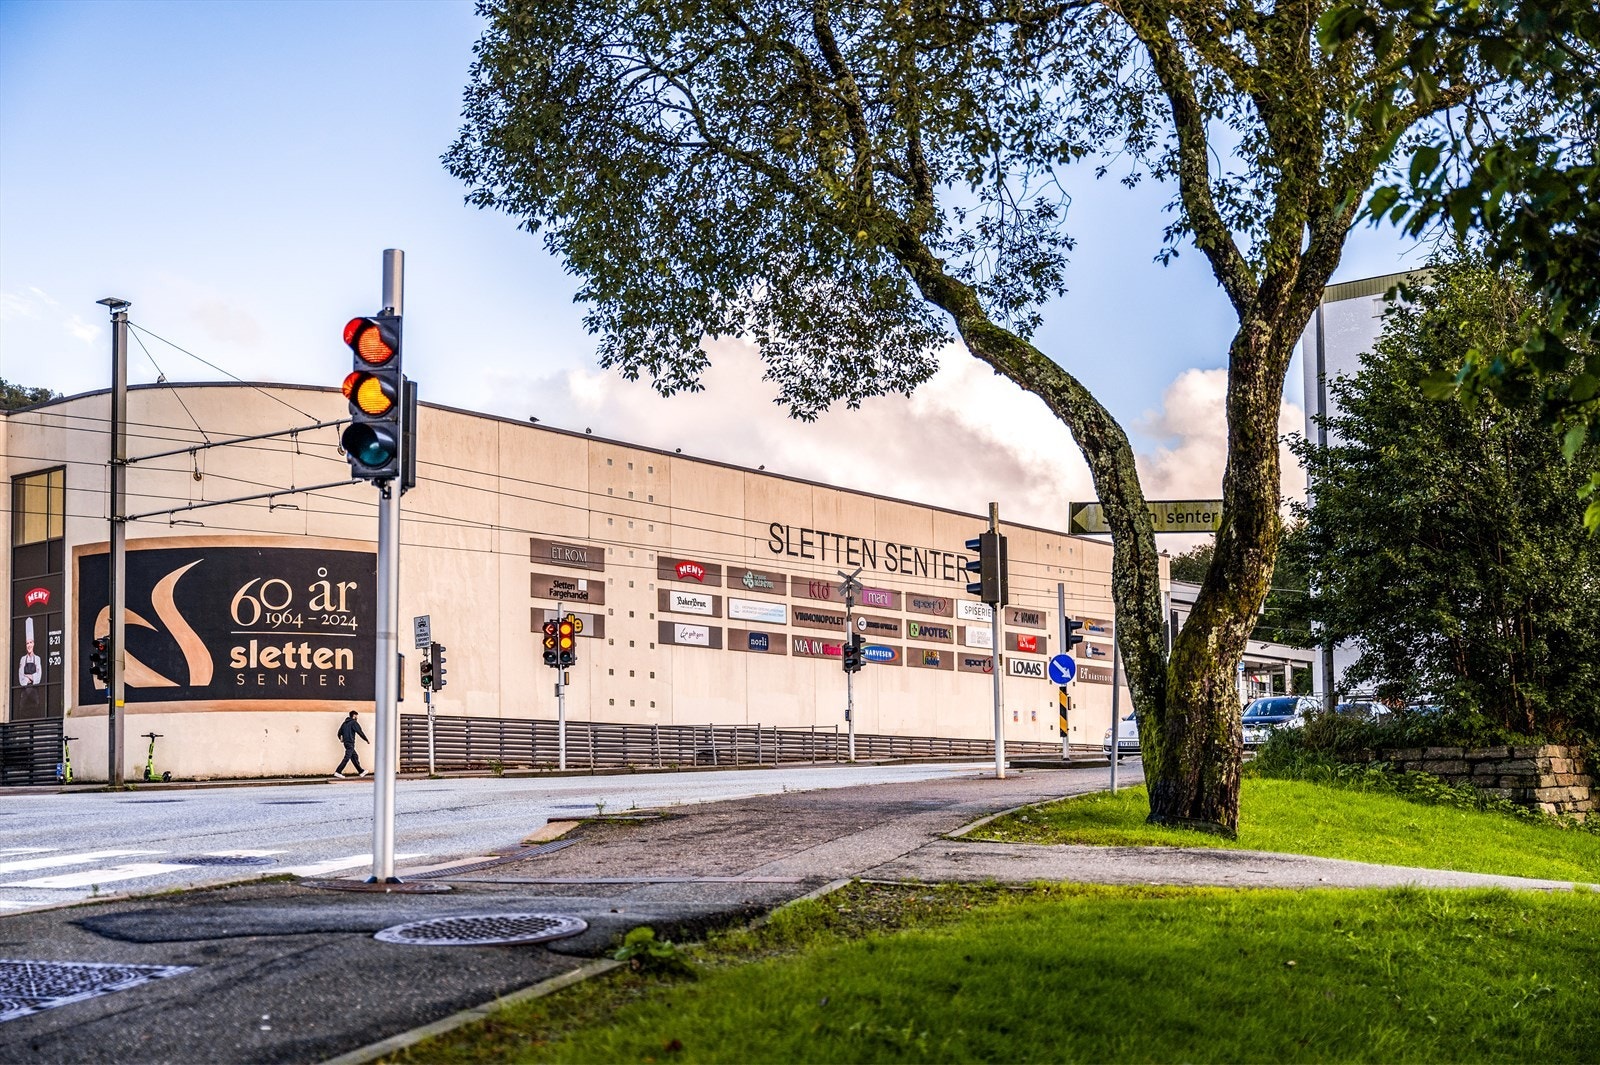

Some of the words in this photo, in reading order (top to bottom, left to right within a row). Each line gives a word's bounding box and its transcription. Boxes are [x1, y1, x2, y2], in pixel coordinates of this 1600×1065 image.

[1166, 511, 1218, 524] senter
[551, 546, 562, 559] ET
[565, 548, 587, 562] ROM
[768, 522, 877, 569] SLETTEN
[884, 542, 970, 583] SENTER
[679, 564, 704, 576] MENY
[553, 580, 575, 590] Sletten
[28, 591, 48, 602] MENY
[230, 577, 293, 627] 60
[308, 567, 358, 612] år
[549, 588, 589, 600] Fargehandel
[265, 608, 304, 629] 1964
[320, 613, 358, 631] 2024
[794, 611, 845, 626] VINMONOPOLET
[49, 636, 61, 646] 8-21
[750, 637, 767, 647] norli
[794, 638, 823, 656] MAXIM
[229, 639, 354, 670] sletten
[864, 648, 893, 659] NARVESEN
[48, 656, 62, 666] 9-20
[236, 673, 346, 686] SENTER
